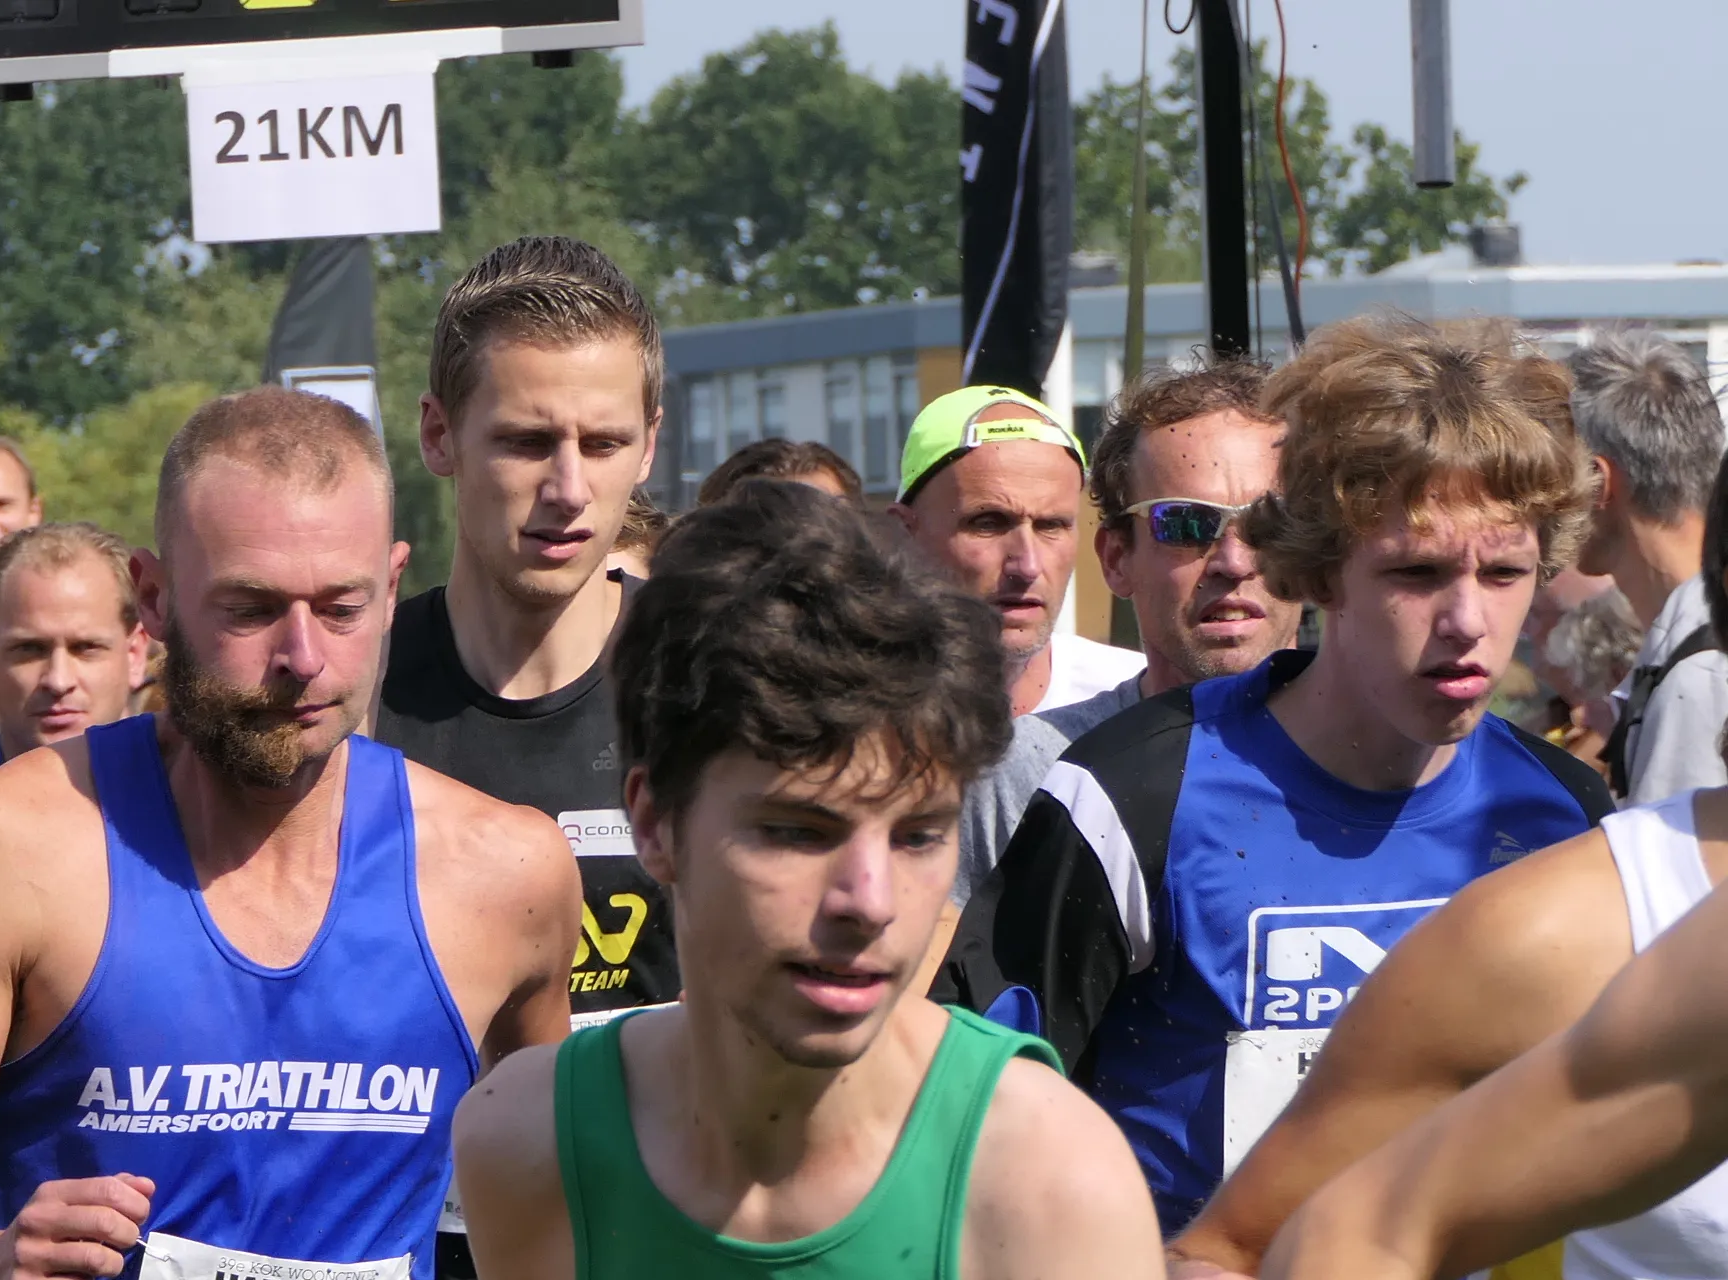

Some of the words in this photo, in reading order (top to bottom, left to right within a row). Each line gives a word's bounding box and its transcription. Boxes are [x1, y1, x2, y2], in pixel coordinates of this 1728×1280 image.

[214, 103, 404, 165] 21KM
[570, 969, 630, 992] TEAM
[77, 1065, 172, 1112] A.V.
[173, 1060, 440, 1112] TRIATHLON
[77, 1111, 287, 1134] AMERSFOORT
[218, 1257, 245, 1273] 39e
[249, 1261, 283, 1278] KOK
